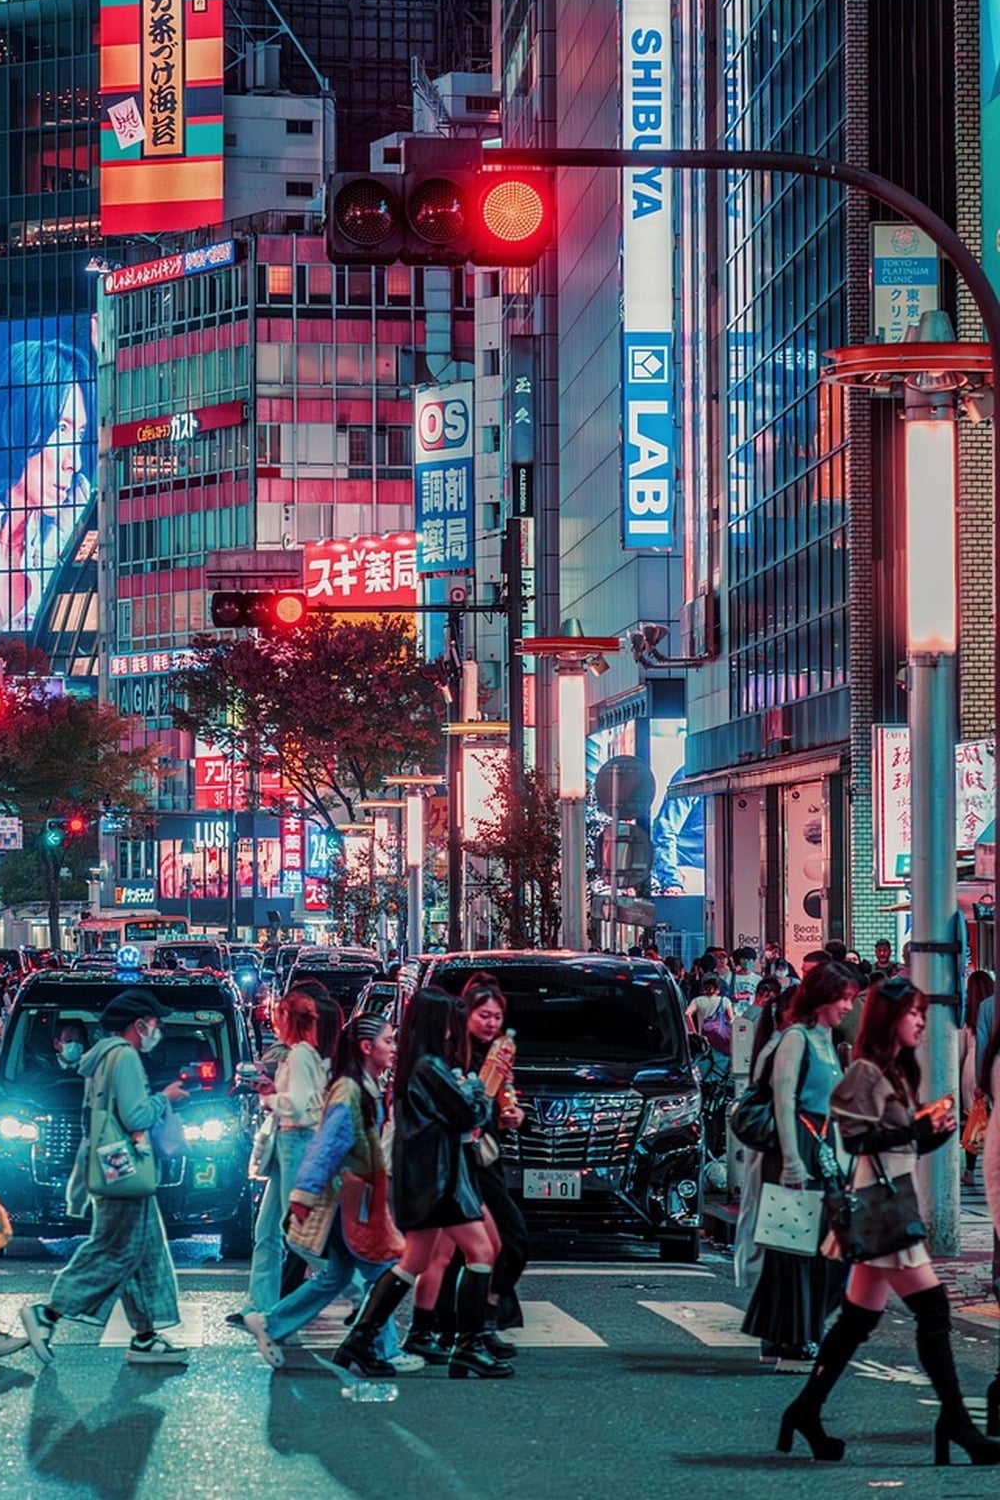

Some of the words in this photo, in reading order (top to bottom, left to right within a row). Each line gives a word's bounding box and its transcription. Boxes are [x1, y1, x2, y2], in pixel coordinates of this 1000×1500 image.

[630, 28, 663, 220] SHIBUYA
[171, 412, 198, 441] ガスト
[420, 402, 466, 443] OS
[628, 401, 669, 535] LABI
[422, 467, 467, 514] 調剤
[422, 518, 468, 563] 薬局
[308, 549, 417, 597] スギ薬局
[121, 683, 156, 713] AGA
[793, 923, 820, 934] Beats
[793, 933, 822, 943] Studio
